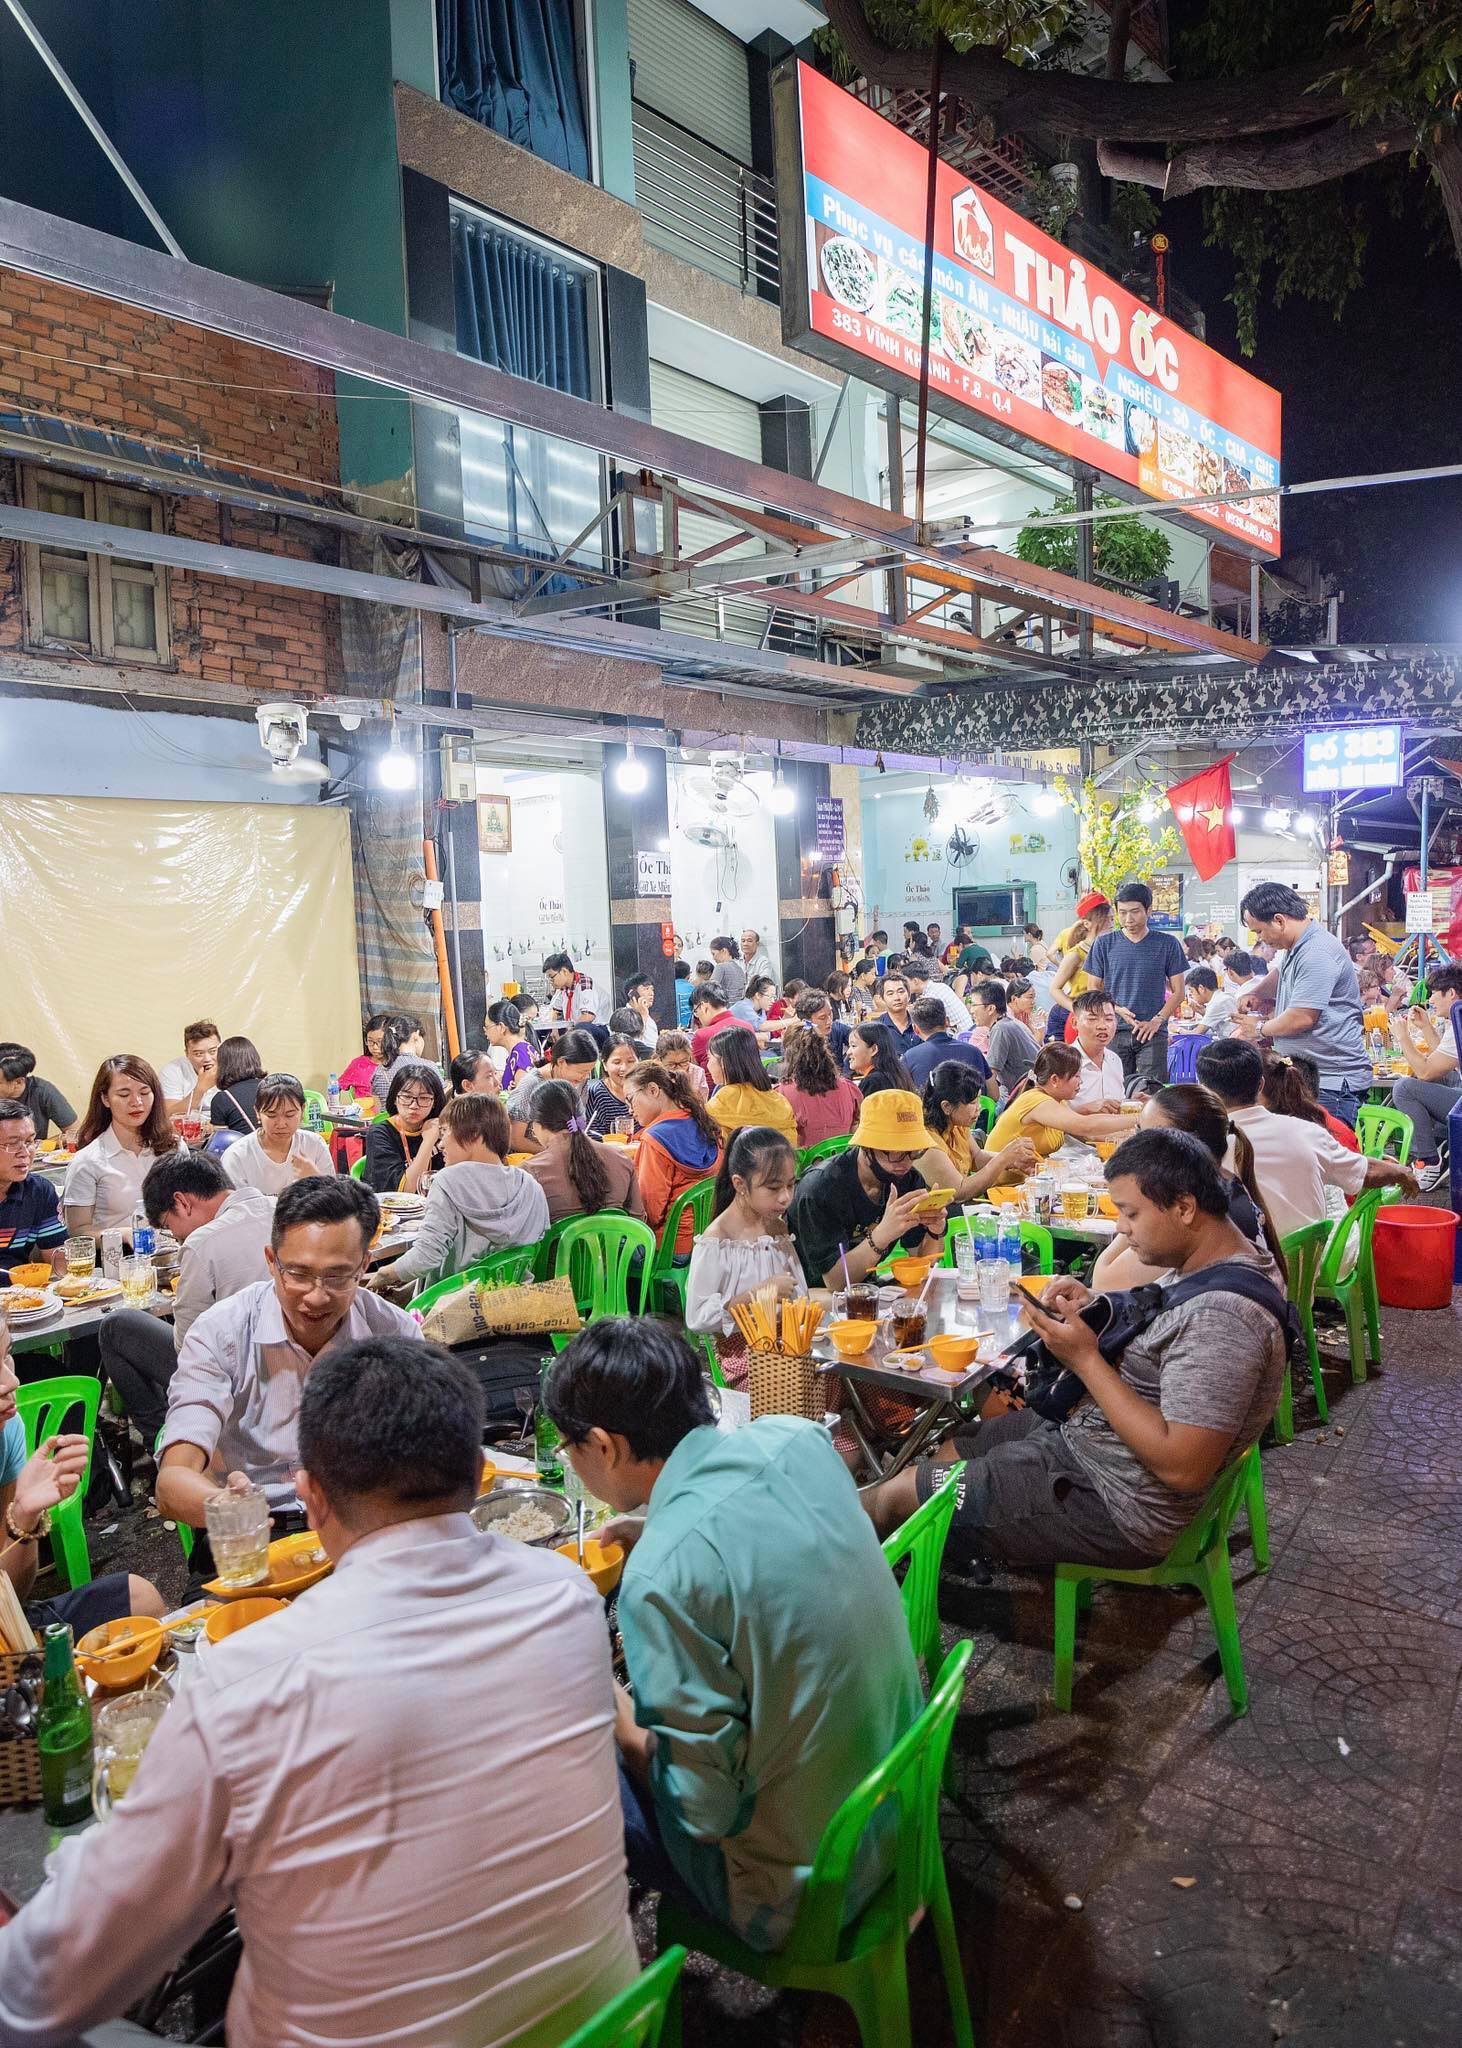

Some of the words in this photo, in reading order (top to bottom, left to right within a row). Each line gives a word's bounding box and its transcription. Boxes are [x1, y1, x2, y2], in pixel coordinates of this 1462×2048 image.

[823, 193, 868, 240] Phục
[873, 229, 894, 260] vụ
[1004, 231, 1121, 355] THẢO
[1130, 308, 1179, 392] ỐC
[831, 308, 862, 338] 383
[962, 376, 982, 400] F.8
[992, 392, 1012, 415] Q.4
[1117, 372, 1162, 415] NGHÊU
[1225, 438, 1247, 465] CUA
[639, 853, 653, 874] Ốc
